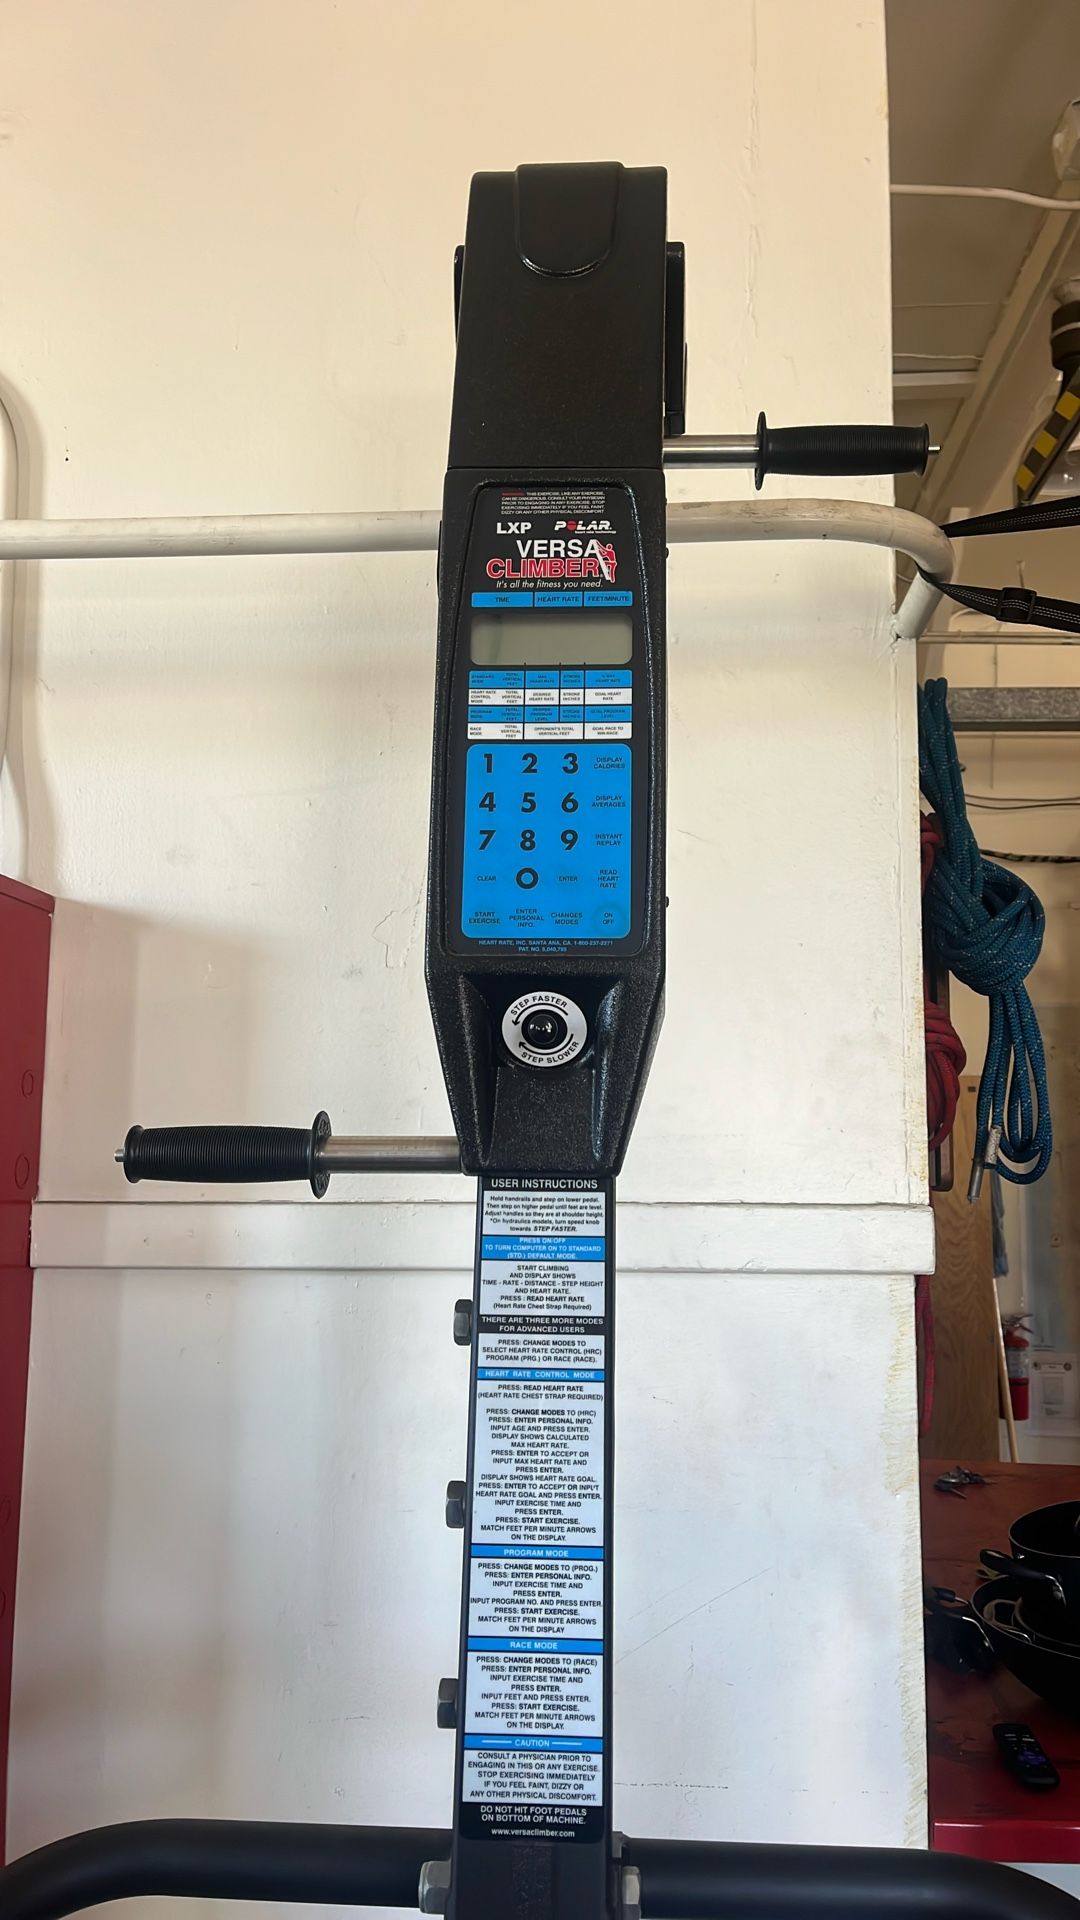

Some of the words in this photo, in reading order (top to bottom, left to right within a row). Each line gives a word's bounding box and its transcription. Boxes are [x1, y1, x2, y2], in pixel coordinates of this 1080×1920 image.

[497, 522, 532, 534] LXP
[516, 539, 599, 558] VERSA
[496, 580, 507, 589] It's
[509, 580, 520, 589] all
[521, 580, 534, 588] the
[536, 579, 561, 588] fitness
[563, 579, 579, 588] you
[483, 753, 493, 774] 1
[521, 753, 538, 774] 2
[562, 753, 579, 774] 3
[478, 792, 497, 812] 4
[521, 792, 537, 813] 5
[561, 792, 579, 813] 6
[479, 830, 496, 850] 7
[519, 829, 536, 851] 8
[560, 829, 579, 850] 9
[511, 998, 530, 1016] STEP
[532, 995, 567, 1008] FASTER
[521, 1051, 544, 1063] STEP
[547, 1041, 579, 1063] SLOWER
[491, 1179, 519, 1188] USER
[521, 1179, 598, 1189] INSTRUCTIONS
[510, 1641, 532, 1649] RACE
[515, 1739, 550, 1747] CAUTION
[477, 1752, 510, 1760] CONSULT
[518, 1753, 556, 1761] PHYSICIAN
[557, 1754, 580, 1762] PRIOR
[499, 1772, 544, 1780] EXERCISING
[546, 1773, 596, 1781] IMMEDIATELY
[495, 1814, 531, 1822] BOTTOM
[532, 1815, 544, 1823] OF
[545, 1816, 586, 1824] MACHINE.
[529, 1807, 552, 1815] FOOT
[554, 1808, 587, 1816] PEDALS
[491, 1828, 575, 1837] www.versaclimber.com
